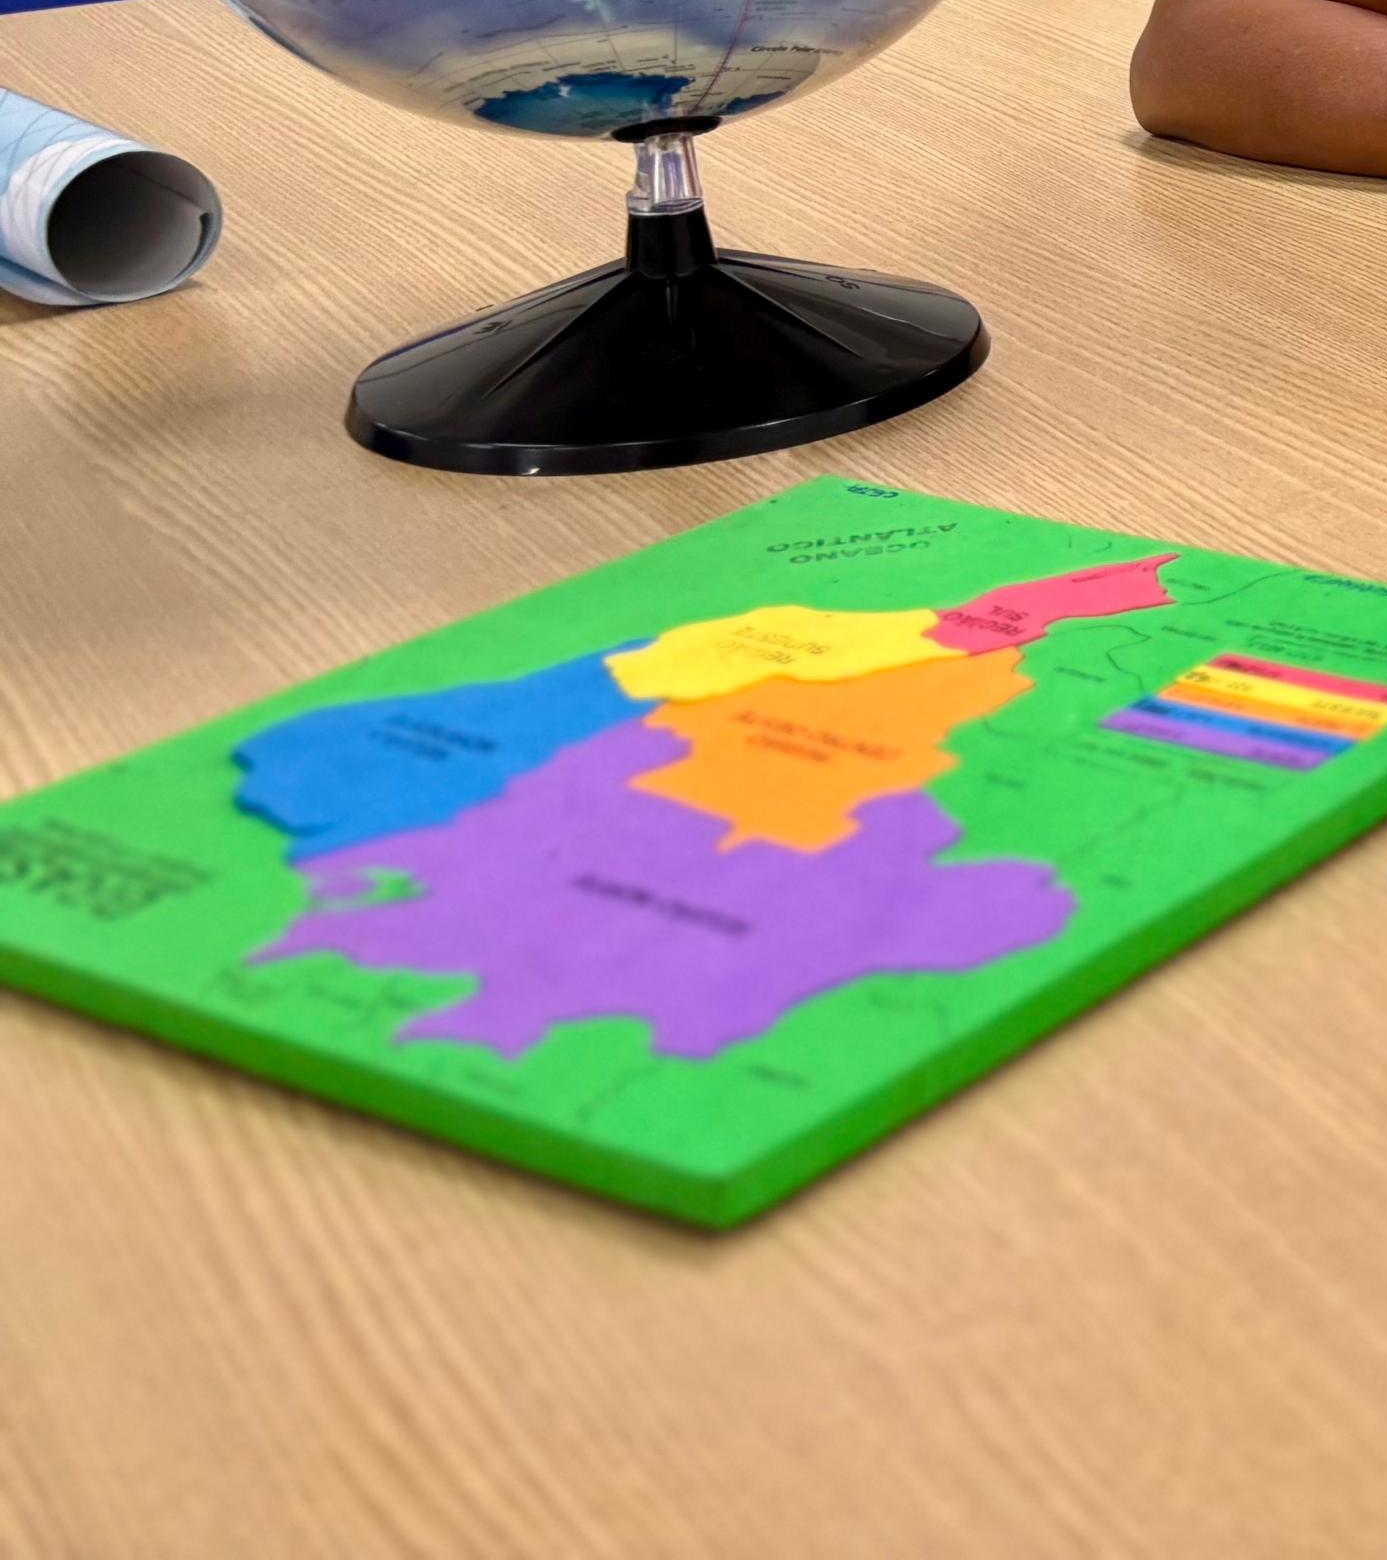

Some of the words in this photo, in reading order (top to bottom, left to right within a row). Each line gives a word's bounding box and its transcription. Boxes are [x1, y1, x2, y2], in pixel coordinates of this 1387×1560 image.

[766, 521, 958, 554] ATLÂNTICO
[788, 540, 932, 565] OCEANO
[943, 611, 1027, 638] REGIÃO
[988, 605, 1030, 622] SUL
